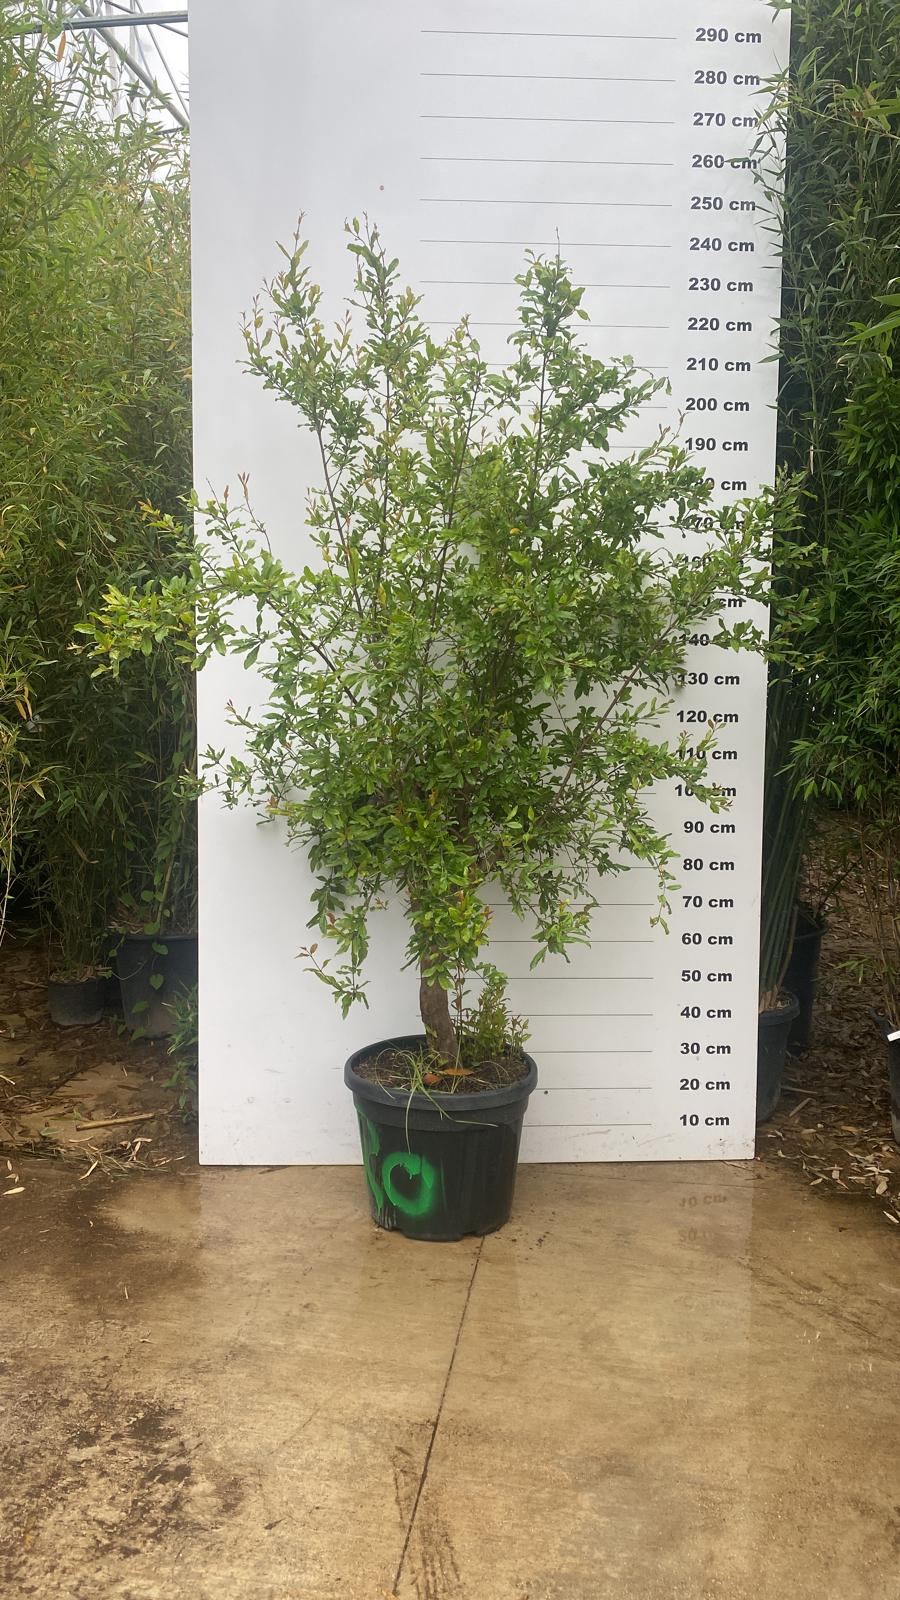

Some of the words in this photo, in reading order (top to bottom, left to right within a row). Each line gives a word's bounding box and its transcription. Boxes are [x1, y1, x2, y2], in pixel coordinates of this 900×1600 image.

[696, 28, 728, 41] 290
[735, 33, 761, 43] cm
[695, 71, 726, 84] 280
[734, 75, 760, 85] cm
[694, 113, 725, 126] 270
[732, 117, 758, 127] cm
[692, 155, 724, 168] 260
[731, 157, 757, 168] cm
[691, 197, 722, 210] 250
[730, 201, 756, 211] cm
[690, 238, 721, 251] 240
[728, 242, 754, 251] cm
[689, 278, 720, 291] 230
[727, 282, 753, 291] cm
[688, 318, 719, 331] 220
[726, 322, 752, 331] cm
[687, 358, 718, 370] 210
[725, 362, 750, 371] cm
[686, 398, 717, 410] 200
[724, 402, 749, 411] cm
[685, 438, 716, 450] 190
[723, 442, 748, 451] cm
[721, 480, 747, 491] cm
[679, 634, 710, 646] 140
[678, 672, 708, 685] 130
[714, 676, 740, 685] cm
[677, 710, 707, 722] 120
[713, 713, 738, 723] cm
[676, 747, 706, 760] 110
[712, 750, 737, 760] cm
[675, 784, 704, 797] 10
[712, 787, 737, 797] m
[684, 821, 704, 833] 90
[710, 824, 736, 834] cm
[683, 859, 703, 870] 80
[709, 862, 735, 871] cm
[683, 896, 702, 907] 70
[708, 899, 734, 908] cm
[682, 933, 702, 945] 60
[708, 936, 733, 945] cm
[681, 970, 701, 982] 50
[707, 973, 732, 982] cm
[681, 1007, 700, 1018] 40
[707, 1010, 732, 1019] cm
[680, 1043, 700, 1055] 30
[706, 1046, 731, 1055] cm
[680, 1079, 699, 1091] 20
[705, 1082, 730, 1091] cm
[680, 1115, 699, 1126] 10
[705, 1118, 729, 1126] cm
